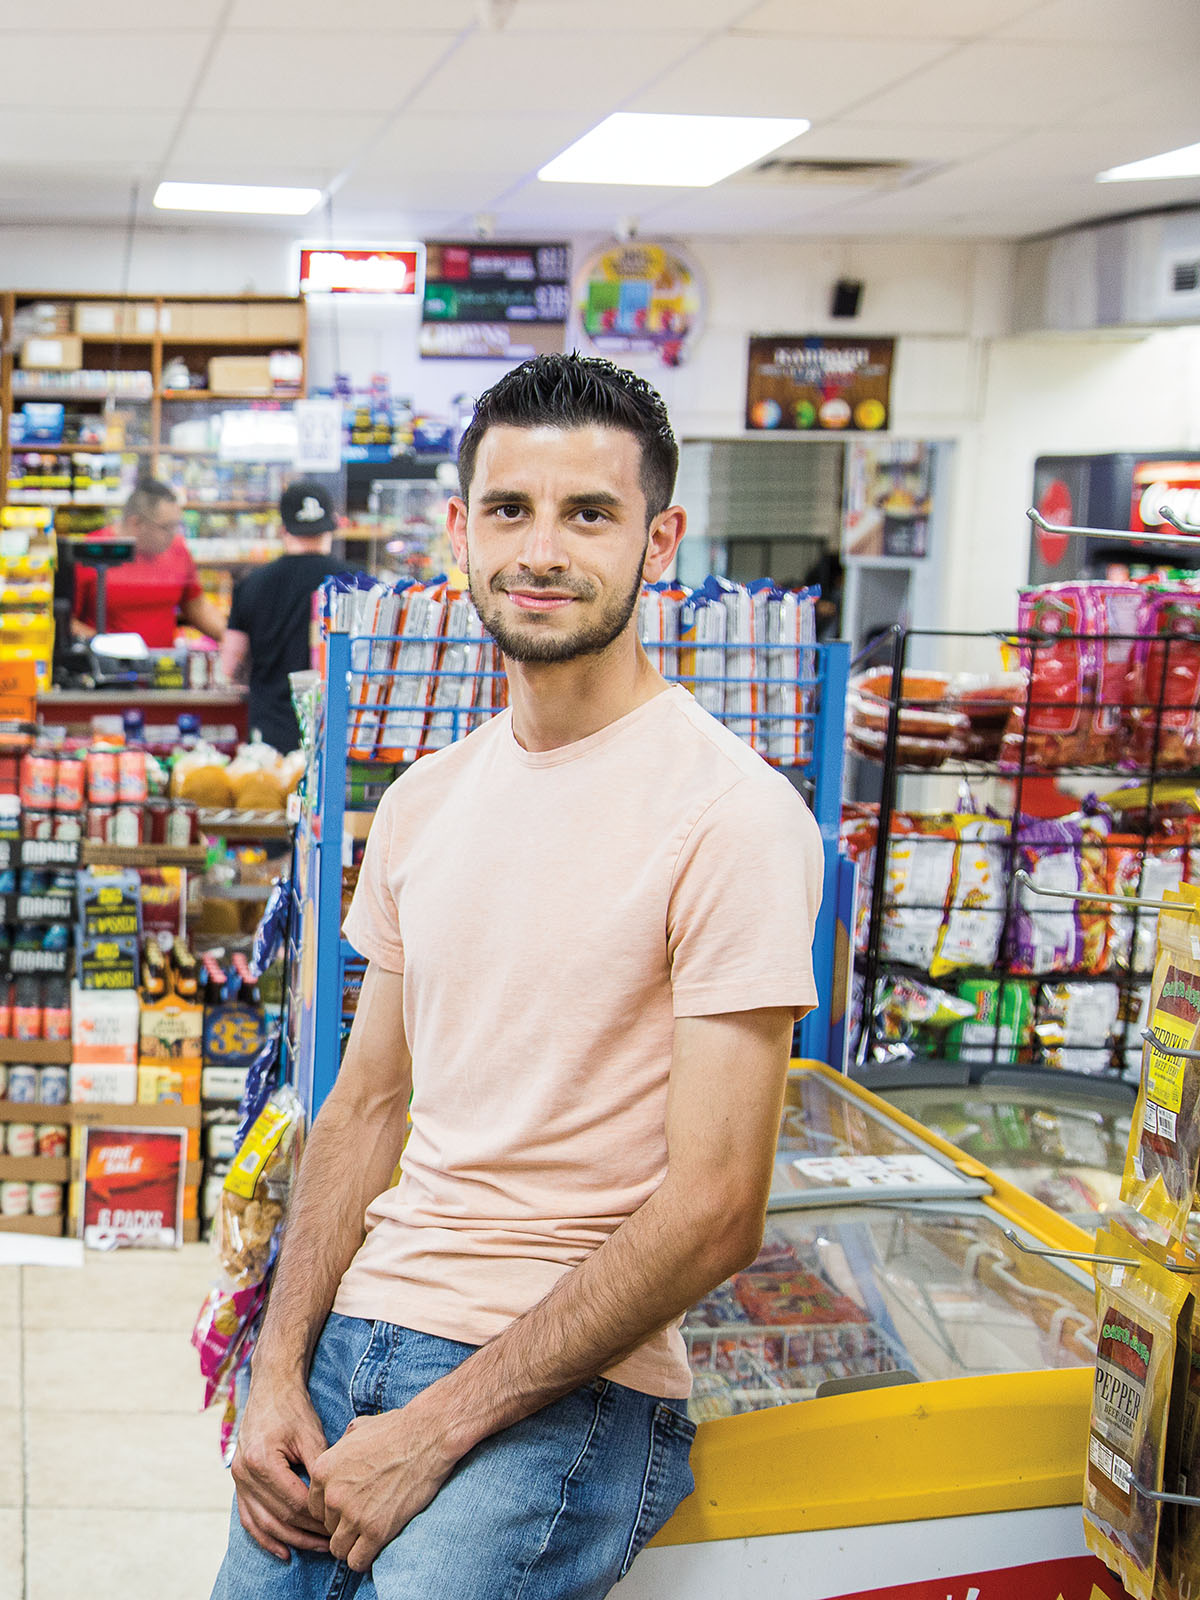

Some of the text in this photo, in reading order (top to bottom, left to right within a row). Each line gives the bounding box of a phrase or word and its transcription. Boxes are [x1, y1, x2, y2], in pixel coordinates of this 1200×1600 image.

[104, 1157, 143, 1175] SALE
[112, 1209, 164, 1229] PACKS
[1096, 1367, 1141, 1422] PEPPER
[1103, 1403, 1120, 1423] BEEF
